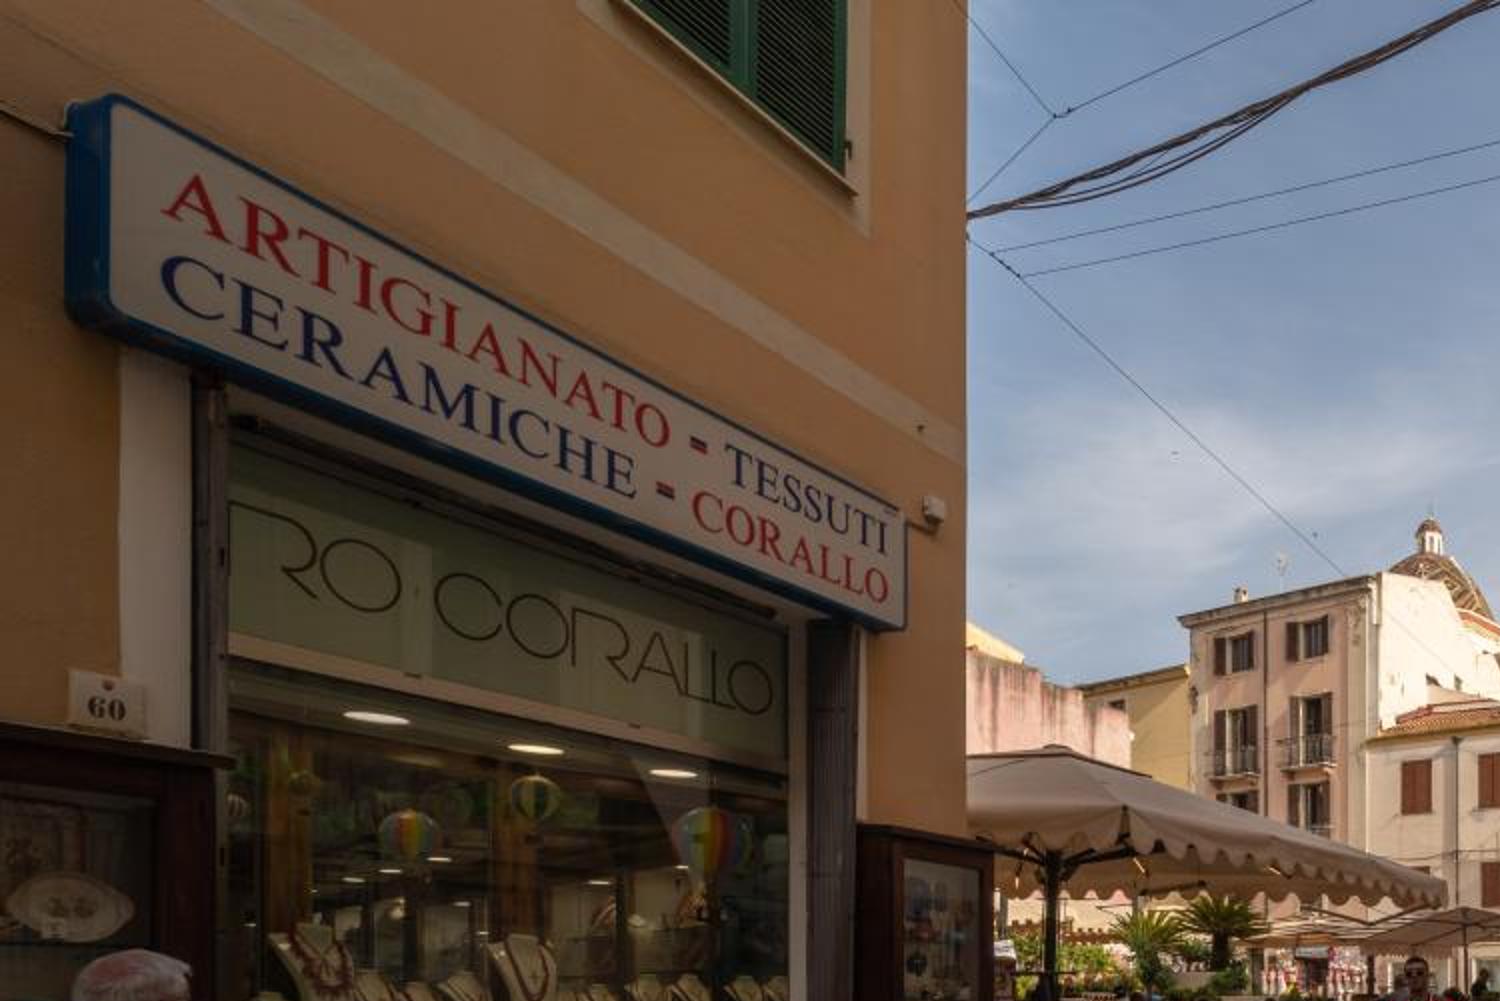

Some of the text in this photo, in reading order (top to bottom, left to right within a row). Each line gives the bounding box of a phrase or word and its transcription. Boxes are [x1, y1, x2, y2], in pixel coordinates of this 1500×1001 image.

[160, 173, 671, 450] ARTIGIANATO
[724, 442, 890, 556] TESSUTI
[160, 255, 637, 499] CERAMICHE
[691, 490, 889, 604] CORALLO
[87, 695, 127, 722] 60
[433, 572, 774, 716] CORALLO
